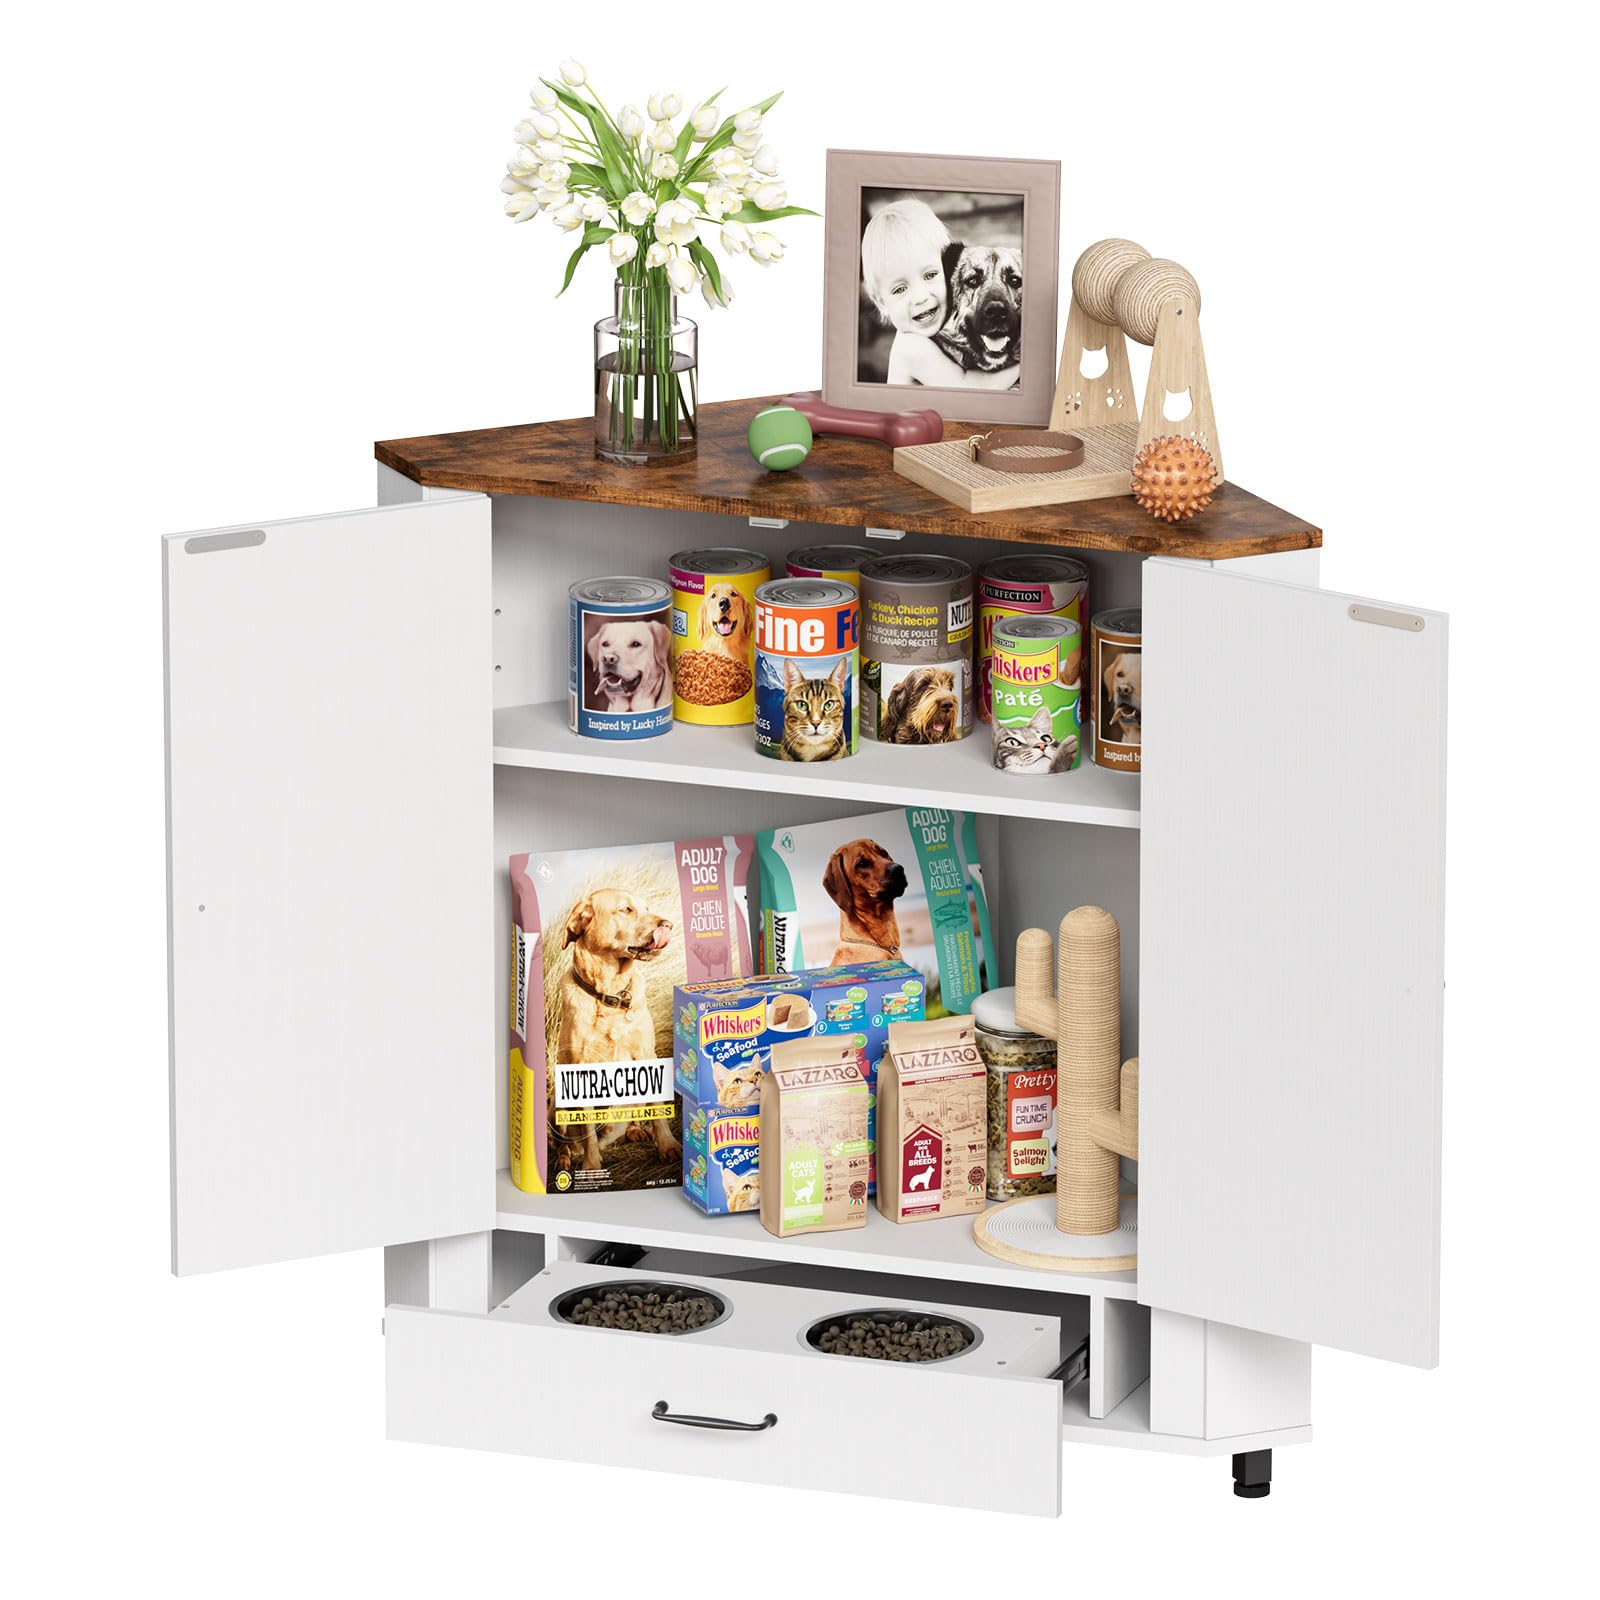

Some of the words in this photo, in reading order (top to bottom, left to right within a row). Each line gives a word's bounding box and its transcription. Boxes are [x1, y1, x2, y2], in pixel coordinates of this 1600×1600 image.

[688, 580, 704, 590] Flavor
[985, 586, 1040, 601] PURFECTION
[868, 599, 897, 615] Turkey,
[897, 604, 938, 615] Chicken
[755, 604, 825, 652] Fine
[871, 613, 878, 621] &
[879, 613, 902, 625] Duck
[903, 616, 938, 627] Recipe
[872, 634, 880, 643] DE
[879, 637, 907, 647] CANARD
[908, 638, 938, 647] RECETTE
[900, 630, 910, 638] DE
[911, 629, 938, 638] POULET
[994, 689, 1043, 707] Paté
[588, 717, 619, 732] Inspired
[621, 720, 632, 733] by
[632, 718, 656, 730] Lucky
[1103, 748, 1132, 762] Inspired
[1134, 751, 1141, 762] b
[921, 825, 947, 845] DOG
[681, 847, 723, 867] ADULT
[928, 858, 956, 876] CHIEN
[690, 866, 718, 885] DOG
[930, 872, 962, 891] ADULTE
[692, 900, 722, 917] CHIEN
[690, 915, 725, 932] ADULTE
[703, 1015, 761, 1039] Whiskers
[716, 1038, 758, 1062] Seafood
[900, 1047, 977, 1070] LAZZARO
[780, 1066, 859, 1087] LAZZARO
[1014, 1073, 1057, 1091] Pretty
[557, 1110, 609, 1123] BALANCED
[611, 1106, 672, 1120] WELLNESS
[1016, 1105, 1029, 1114] FUN
[1030, 1103, 1047, 1113] TIME
[1015, 1113, 1047, 1125] CRUNCH
[514, 1127, 523, 1161] DOG
[914, 1139, 933, 1147] ADULT
[914, 1150, 931, 1160] ALL
[1013, 1147, 1047, 1158] Salmon
[1014, 1155, 1046, 1166] Delight
[789, 1159, 818, 1170] ADULT
[908, 1157, 937, 1167] BREEDS
[791, 1168, 816, 1178] CATS
